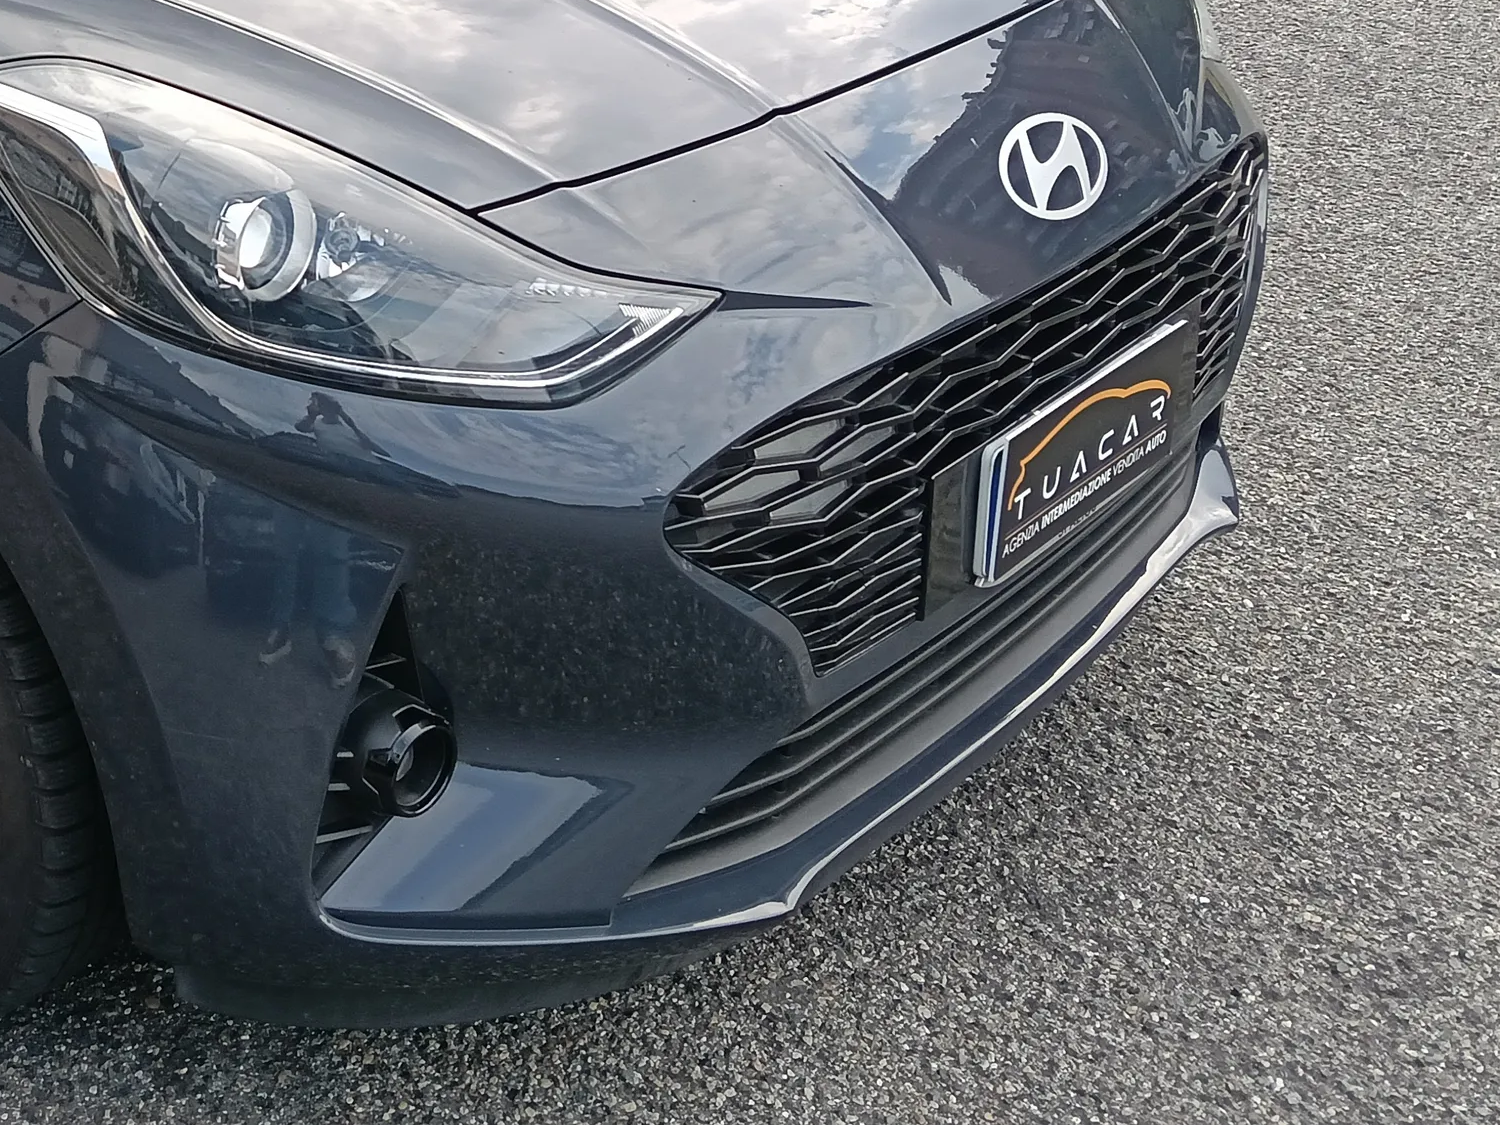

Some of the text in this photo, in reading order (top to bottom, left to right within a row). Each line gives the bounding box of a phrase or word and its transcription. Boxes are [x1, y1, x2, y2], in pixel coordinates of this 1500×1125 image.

[1002, 521, 1040, 559] AGENZIA
[1040, 467, 1112, 530] INTERMEDIAZIONE
[1112, 446, 1145, 477] VENDITA
[1145, 429, 1167, 454] AUTO
